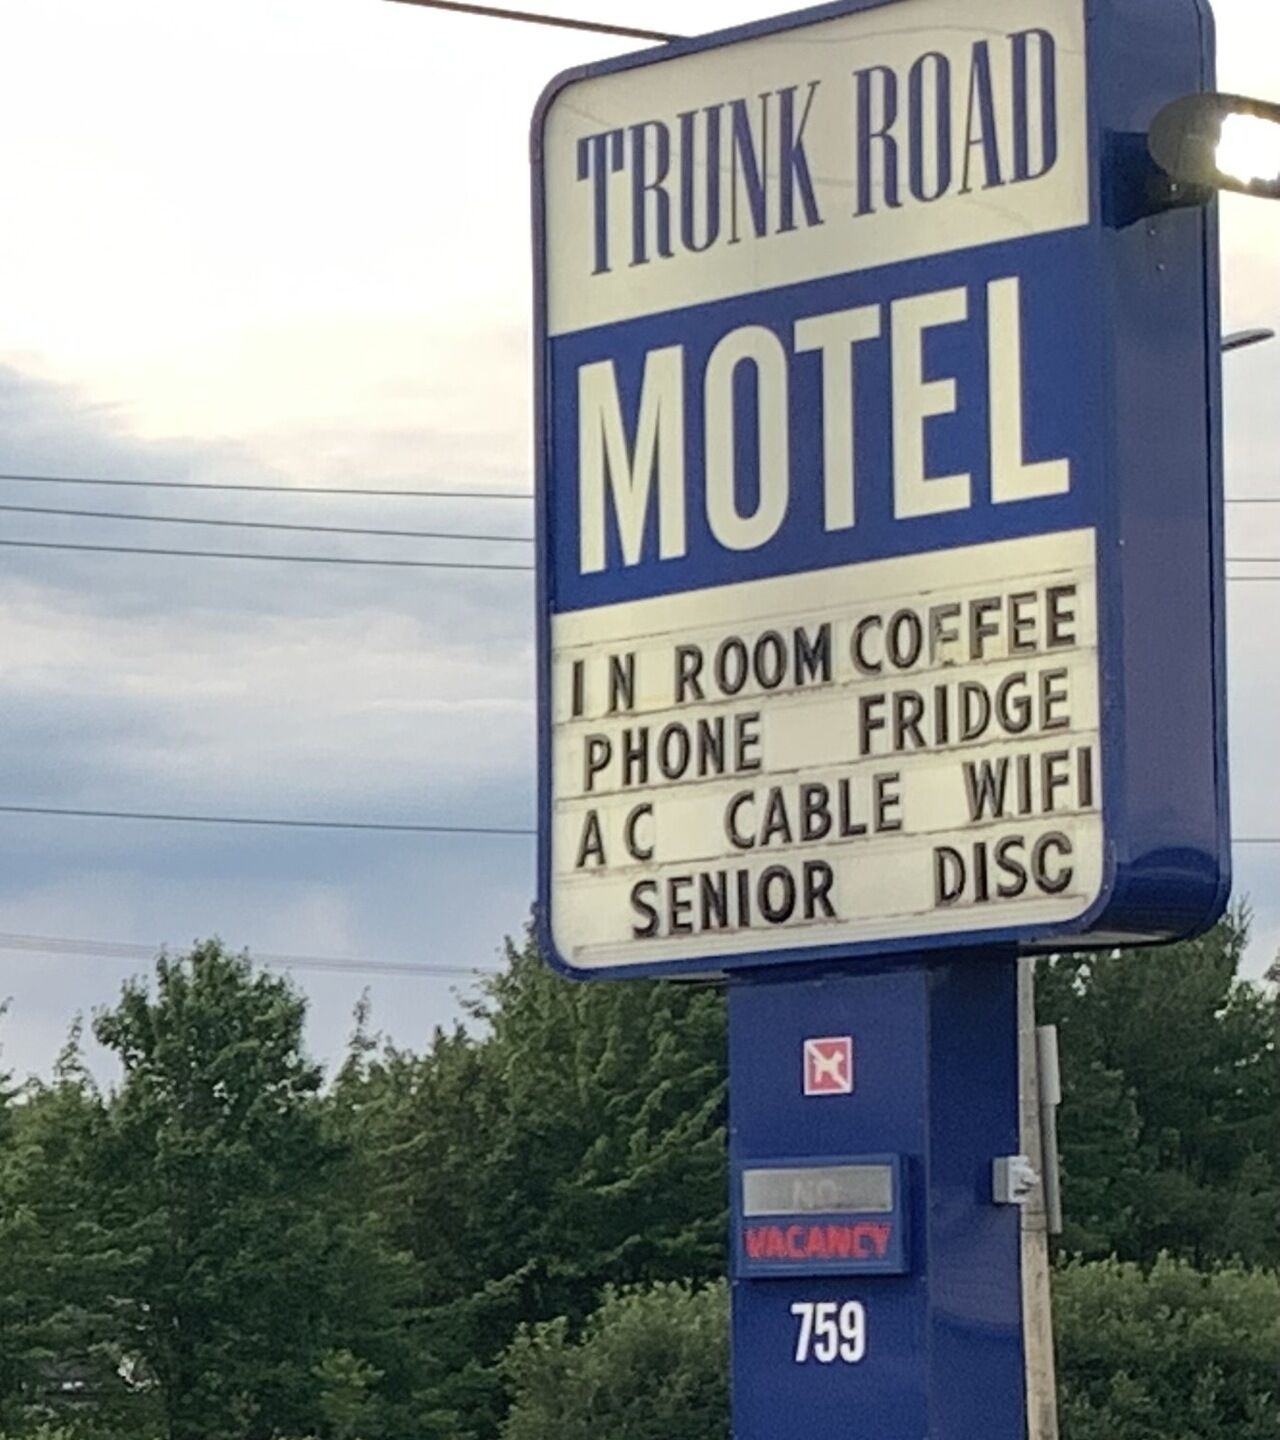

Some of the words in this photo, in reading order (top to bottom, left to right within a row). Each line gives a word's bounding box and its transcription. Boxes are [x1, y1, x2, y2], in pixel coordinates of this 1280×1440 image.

[576, 82, 824, 276] TRUNK
[852, 28, 1058, 217] ROAD
[578, 276, 1070, 575] MOTEL
[571, 652, 635, 716] IN
[674, 623, 831, 702] ROOM
[851, 585, 1077, 675] COFFEE
[584, 711, 762, 791] PHONE
[858, 667, 1069, 755] FRIDGE
[725, 772, 901, 848] CABLE
[963, 746, 1093, 820] WIFI
[630, 860, 836, 938] SENIOR
[933, 830, 1074, 904] DISC
[743, 1221, 892, 1259] VACANCY
[790, 1301, 866, 1362] 759
